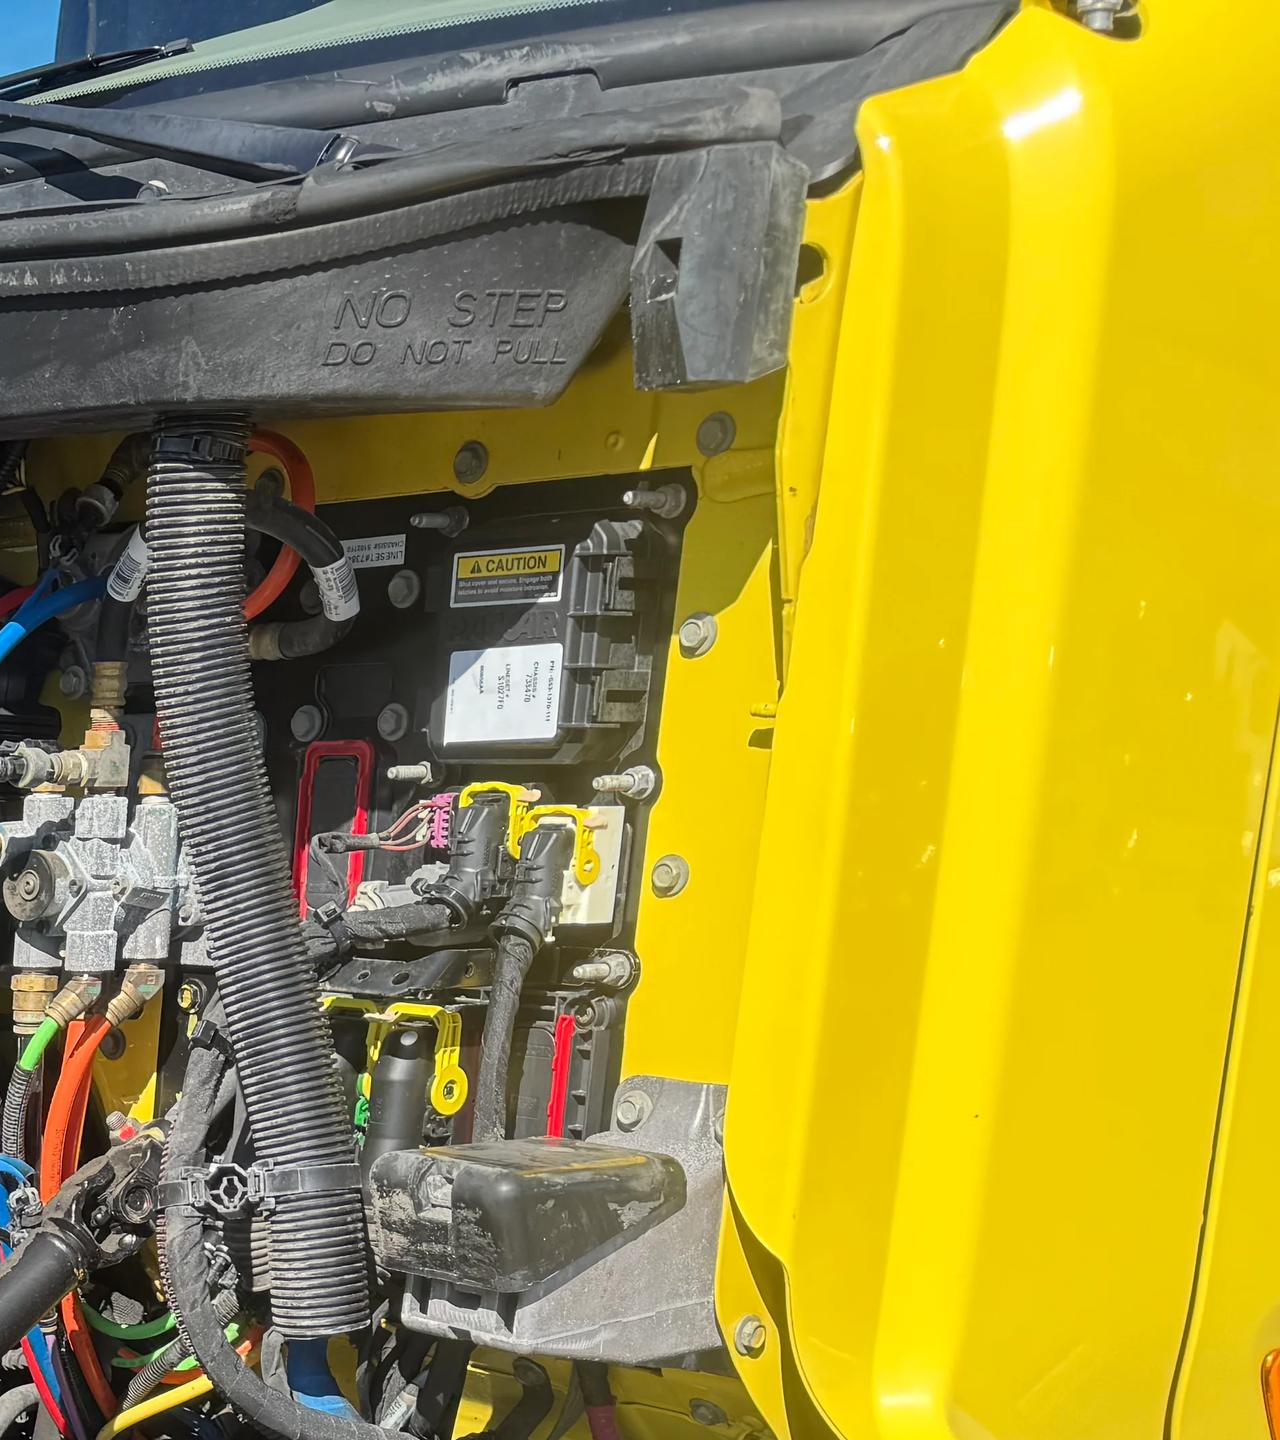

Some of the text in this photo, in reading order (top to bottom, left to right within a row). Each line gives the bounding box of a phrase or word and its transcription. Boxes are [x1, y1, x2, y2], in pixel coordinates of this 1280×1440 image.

[333, 289, 568, 330] NO STEP
[321, 338, 567, 367] DO NOT PULL
[486, 556, 547, 572] CAUTION
